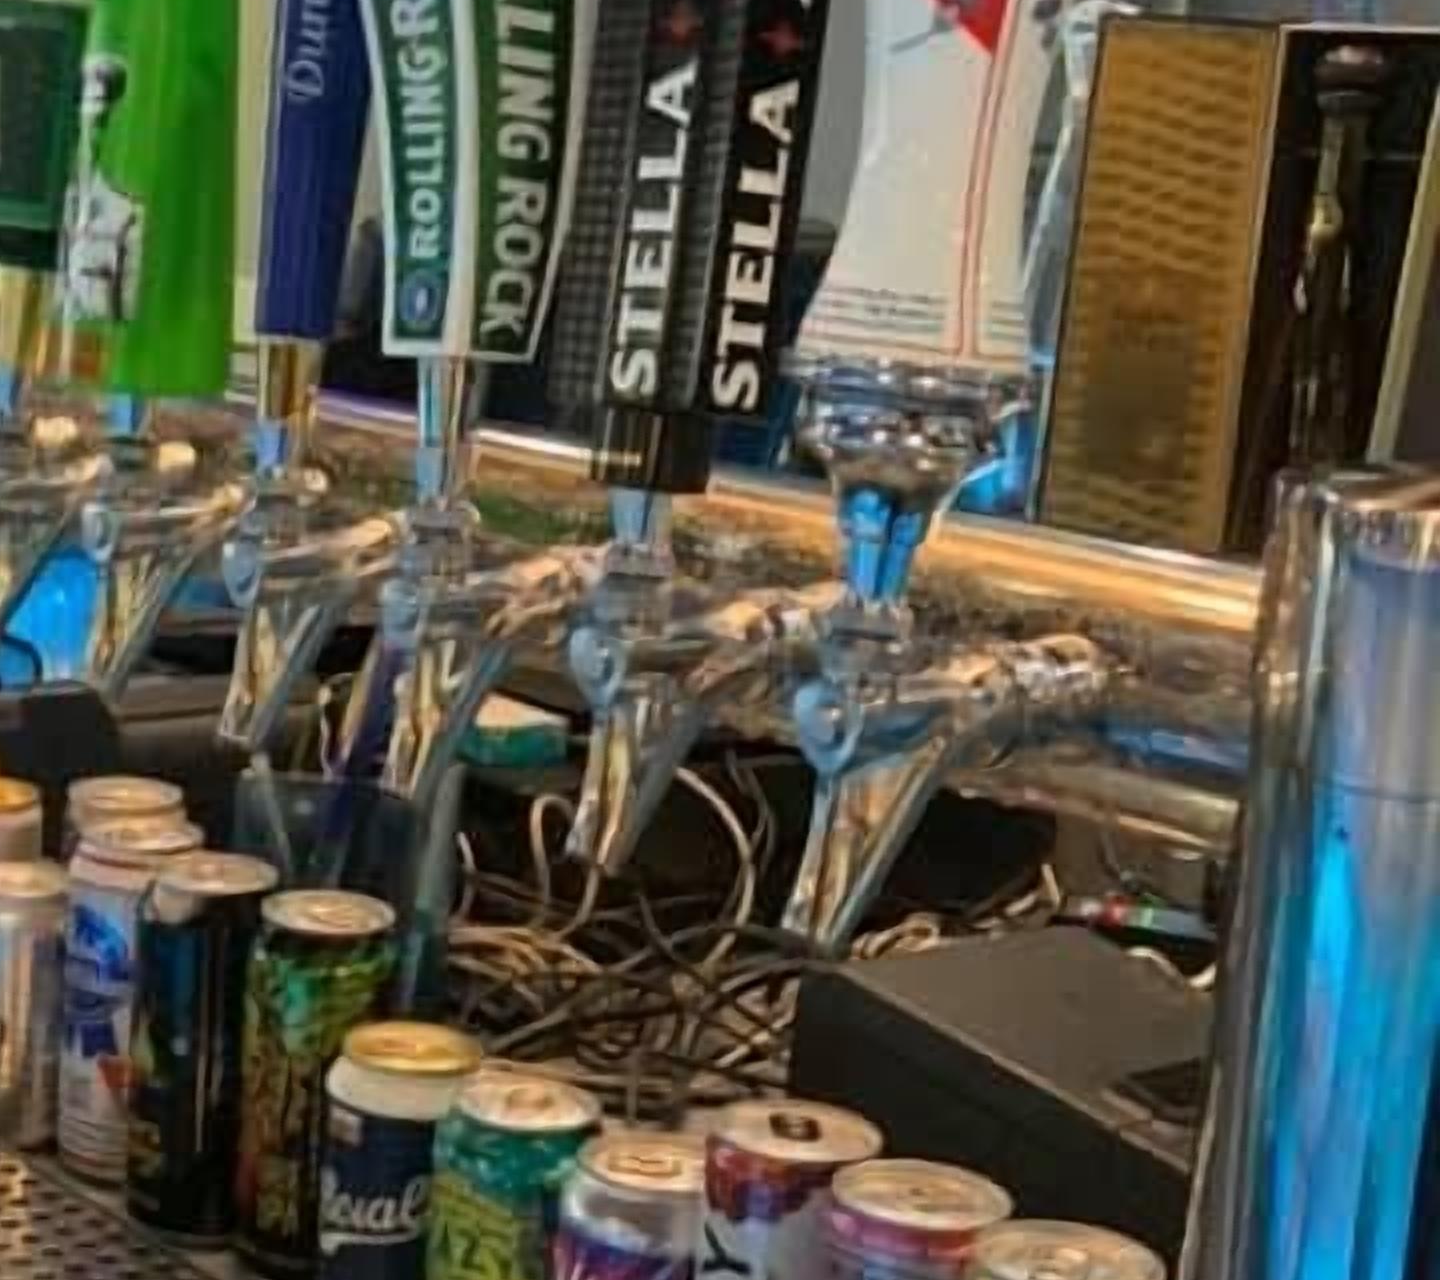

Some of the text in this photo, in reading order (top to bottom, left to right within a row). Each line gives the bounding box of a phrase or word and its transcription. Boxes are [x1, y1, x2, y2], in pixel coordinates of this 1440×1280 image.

[397, 45, 448, 260] ROLLING
[478, 178, 550, 340] ROCK
[611, 64, 697, 396] STELLA
[712, 79, 800, 413] STELLA
